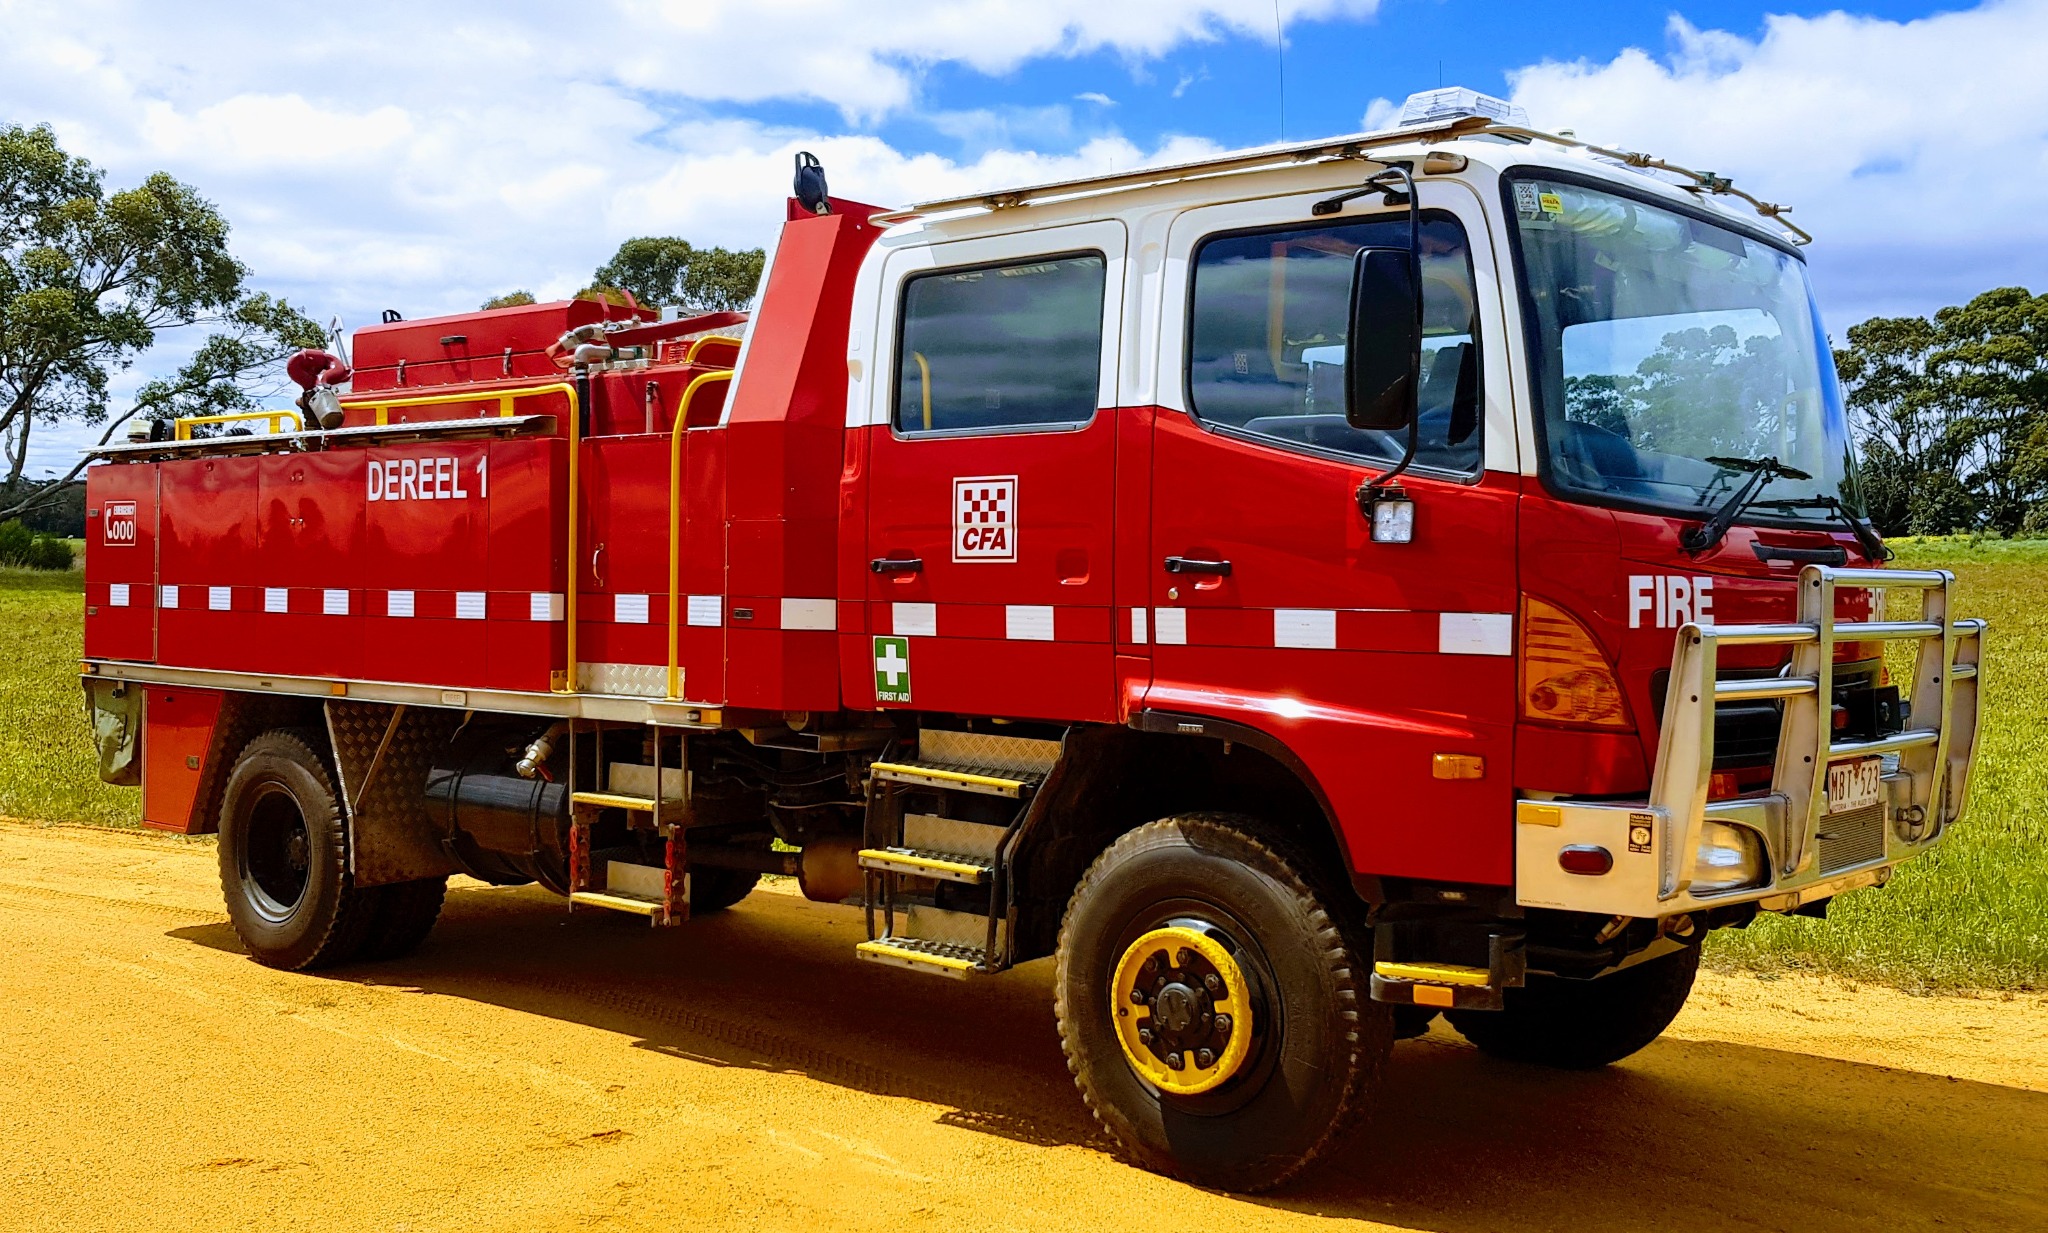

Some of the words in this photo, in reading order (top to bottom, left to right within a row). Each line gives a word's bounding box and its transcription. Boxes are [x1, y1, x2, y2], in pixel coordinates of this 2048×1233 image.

[368, 457, 467, 501] DEREEL
[476, 455, 487, 498] 1
[113, 520, 134, 540] 000
[963, 527, 1007, 551] CFA
[1628, 575, 1714, 629] FIRE
[878, 691, 897, 701] FIRST
[898, 692, 909, 702] AID
[1831, 769, 1852, 802] MBT
[1860, 764, 1878, 796] 523
